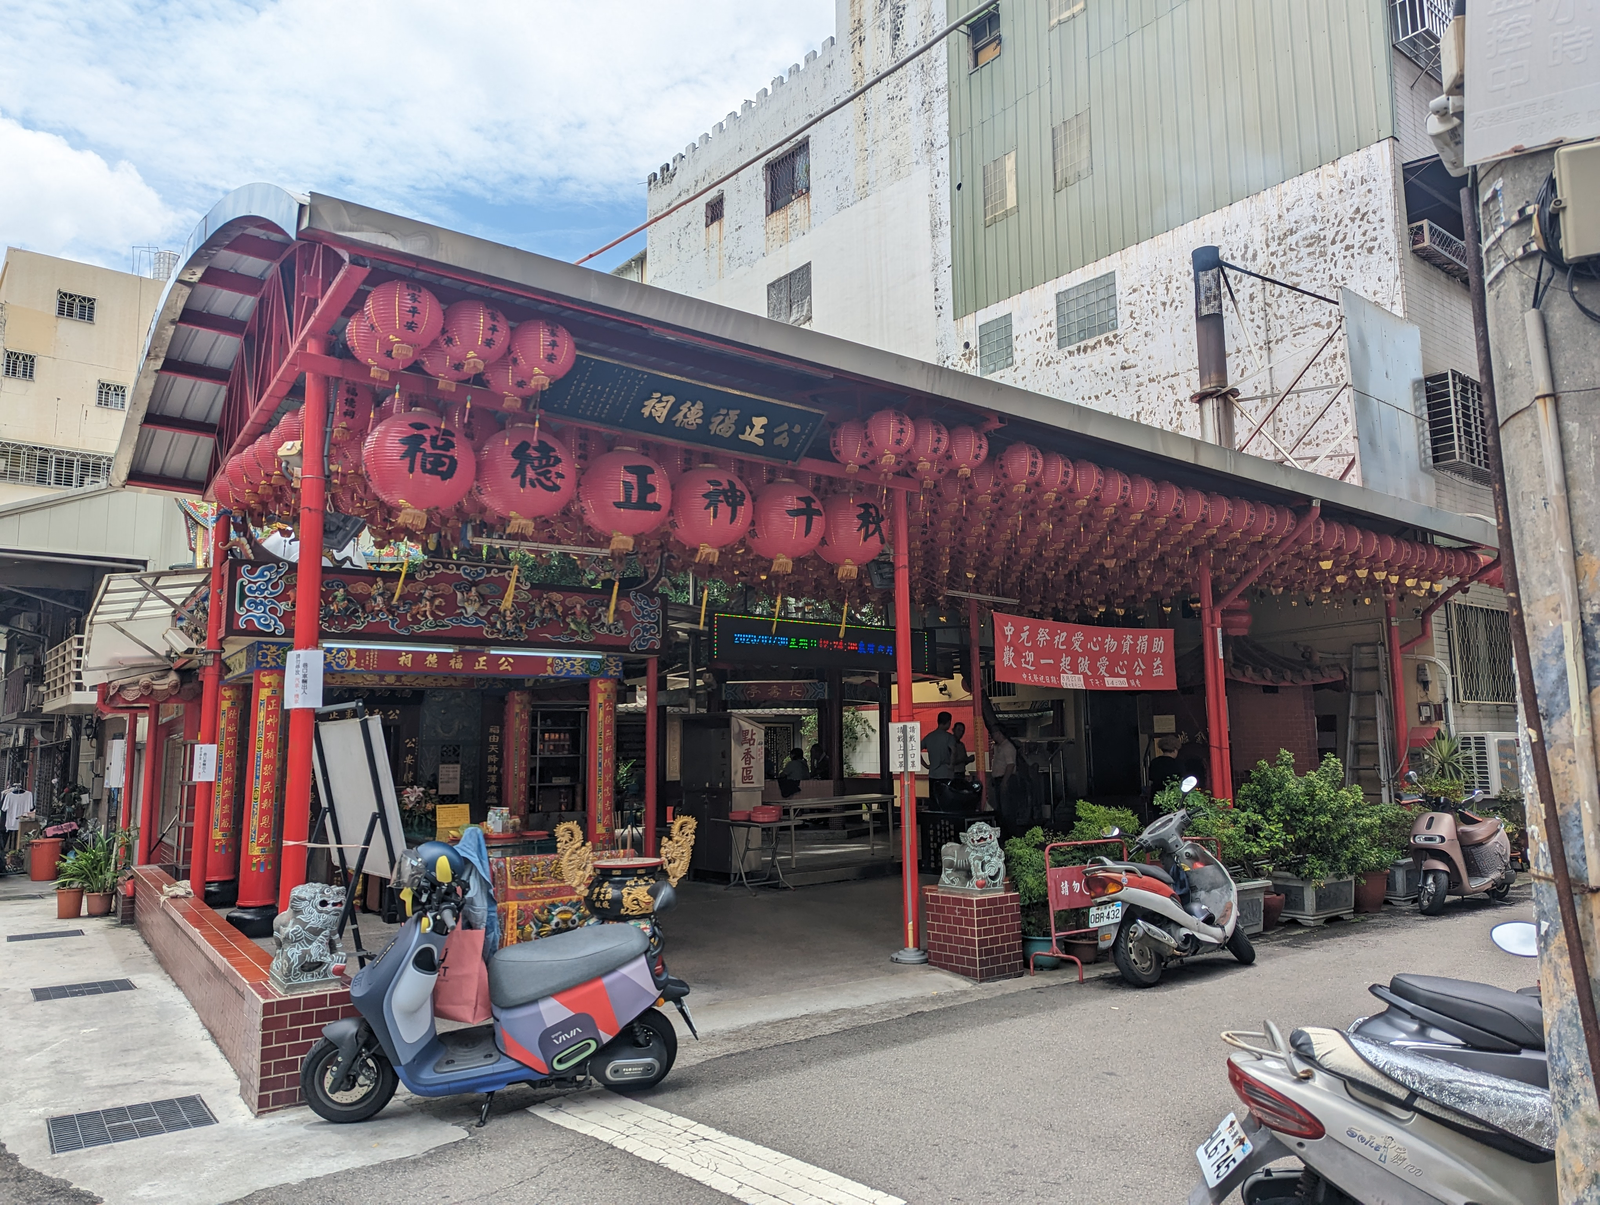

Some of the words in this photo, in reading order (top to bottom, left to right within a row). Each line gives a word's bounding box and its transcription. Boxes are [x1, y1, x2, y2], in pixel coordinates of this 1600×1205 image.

[398, 421, 458, 482] 福
[511, 439, 565, 493] 德
[612, 464, 663, 512] 正
[702, 478, 747, 525] 神
[785, 495, 823, 539] 千
[855, 502, 886, 546] 秋
[1002, 621, 1166, 656] 中元祭祀愛心物資捐助
[1001, 645, 1165, 678] 歡迎一起做愛心公益
[740, 728, 757, 785] 點香區
[553, 1027, 583, 1046] VIVA
